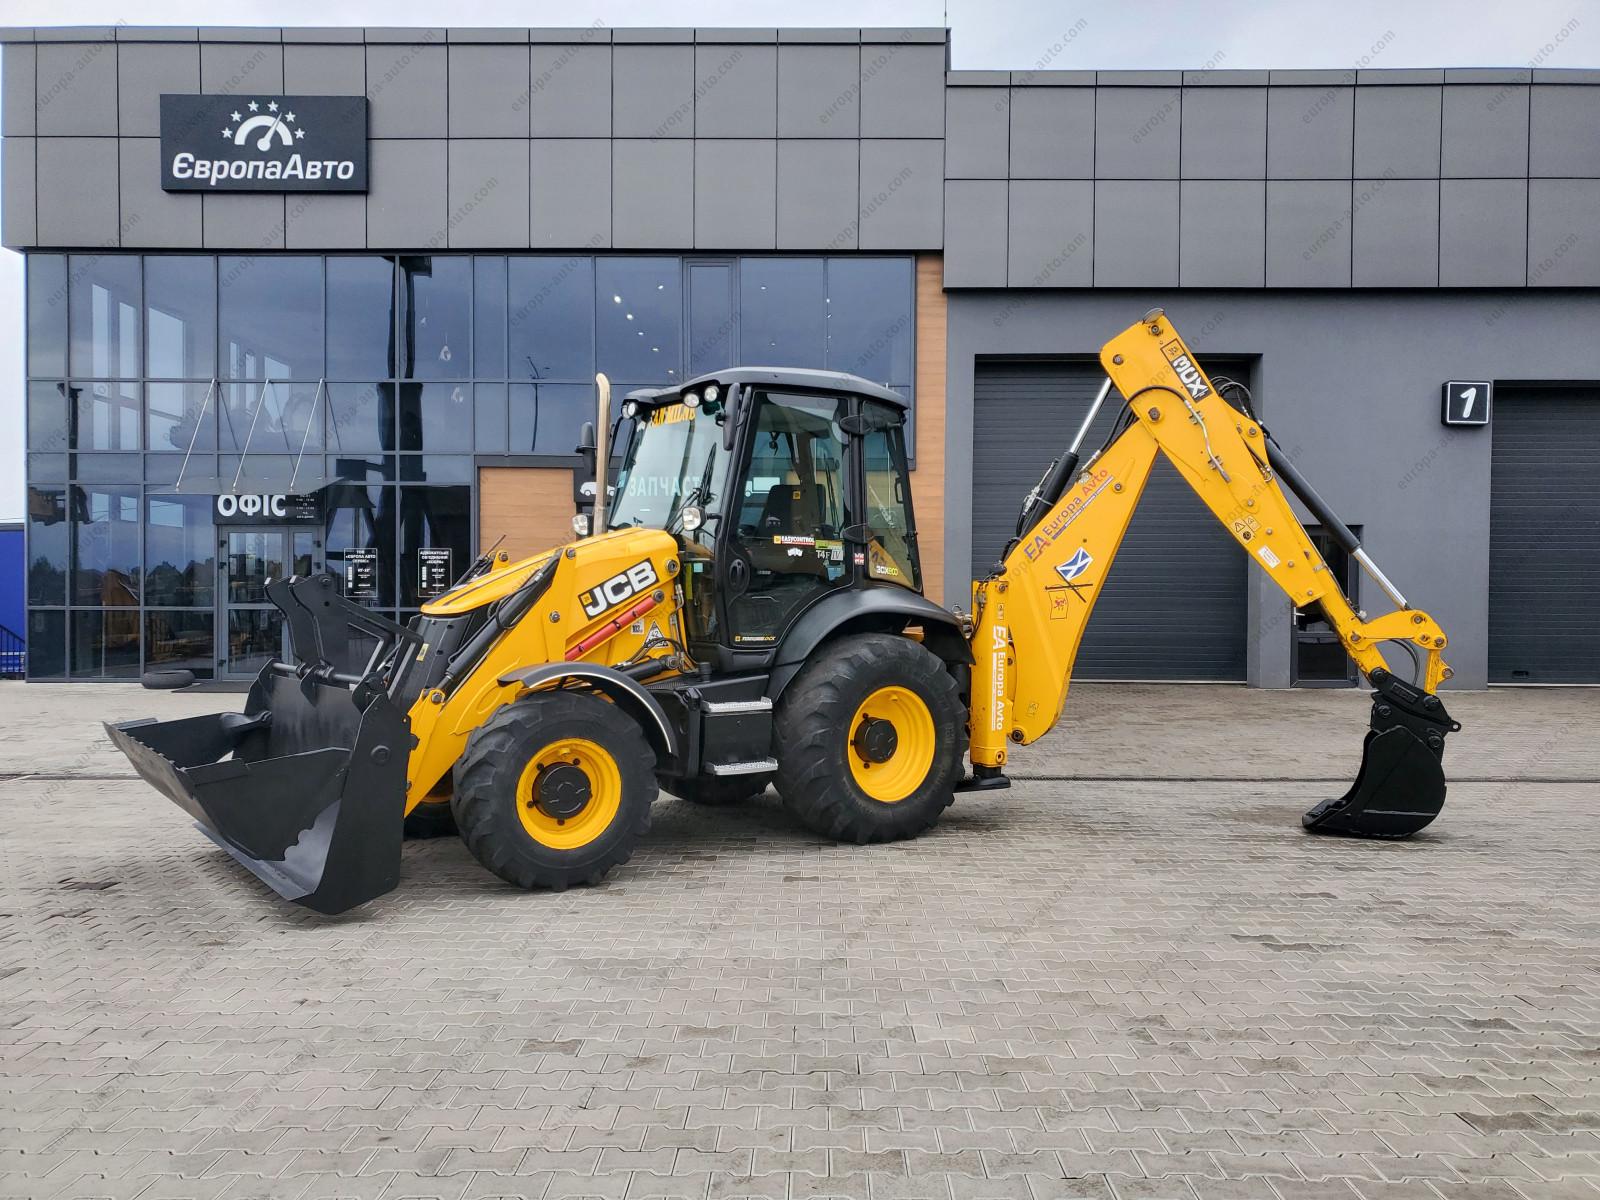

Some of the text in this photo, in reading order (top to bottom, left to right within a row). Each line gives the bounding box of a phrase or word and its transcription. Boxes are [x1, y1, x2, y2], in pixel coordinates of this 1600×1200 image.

[172, 152, 354, 186] ЄвропаАвто
[1460, 387, 1477, 419] 1
[628, 475, 704, 497] ЗАПЧАСТ
[217, 494, 286, 517] ОФІС
[1024, 534, 1052, 563] EA
[1042, 495, 1082, 536] Europa
[1081, 468, 1108, 498] Avto
[585, 560, 658, 617] JCB
[992, 625, 1006, 650] EA
[996, 651, 1006, 697] Europa
[996, 700, 1006, 730] Avto
